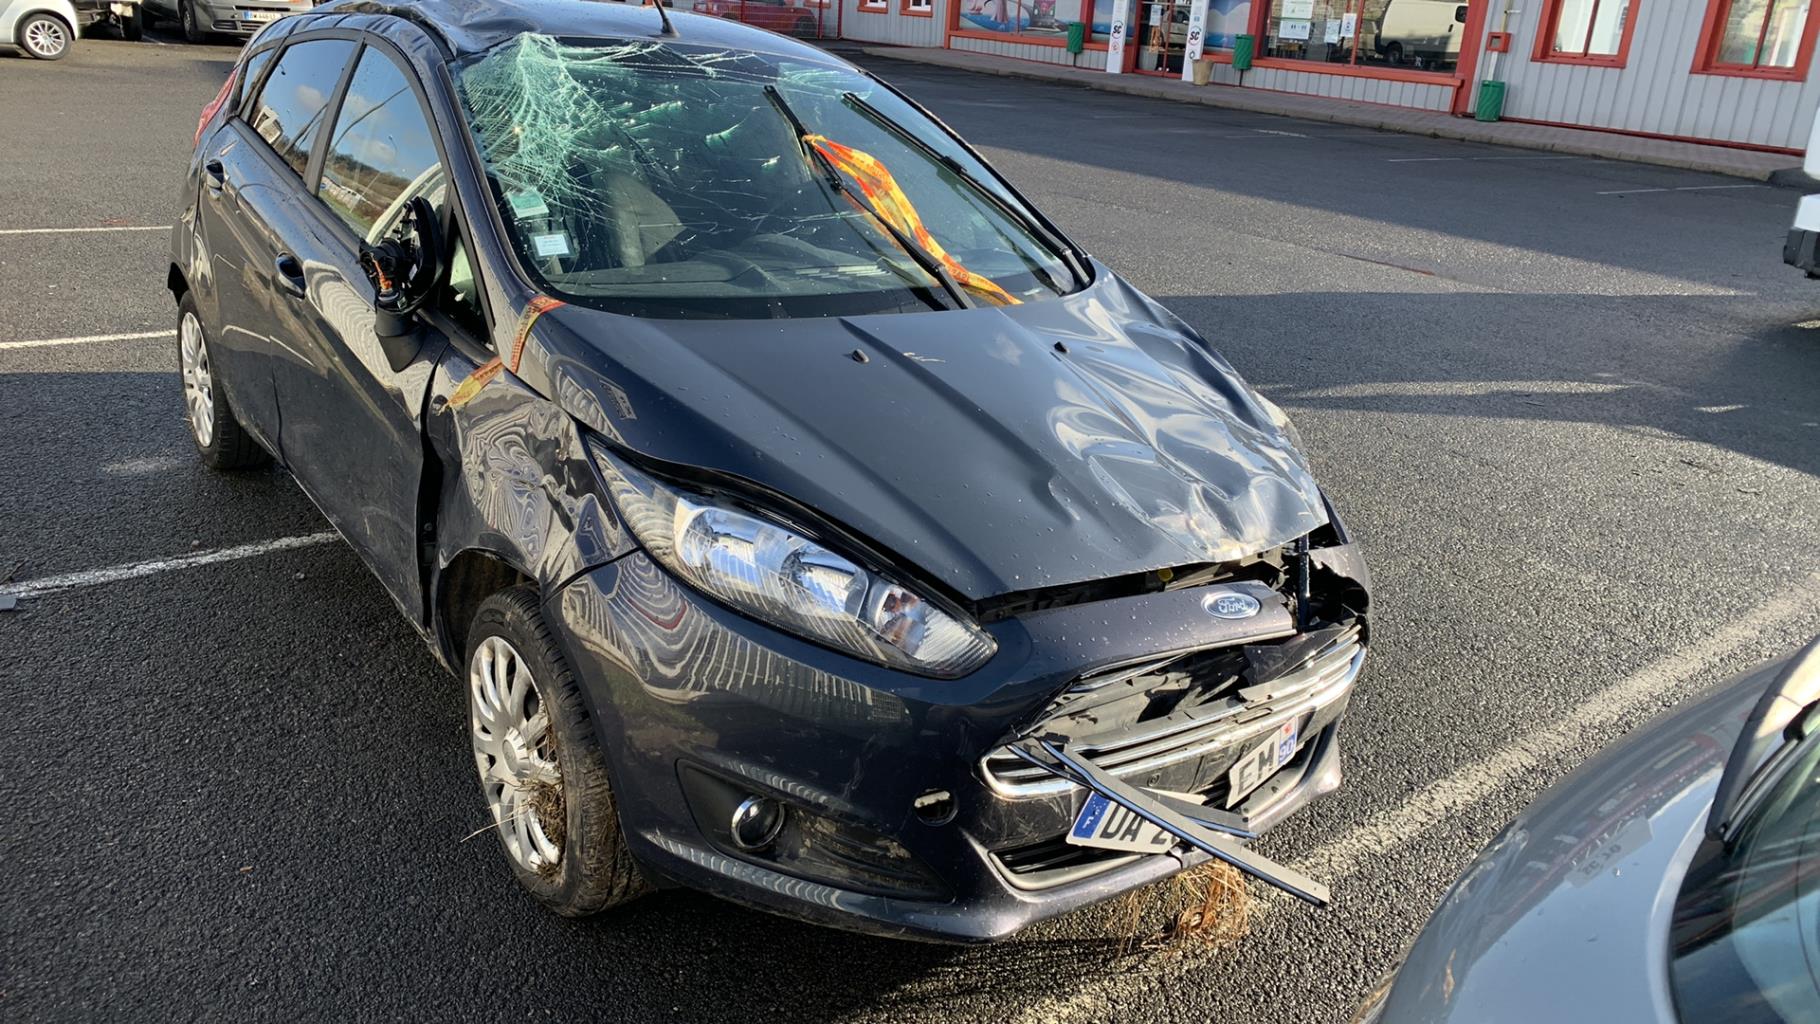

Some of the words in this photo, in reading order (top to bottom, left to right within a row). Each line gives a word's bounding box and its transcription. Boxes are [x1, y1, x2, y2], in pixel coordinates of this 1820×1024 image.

[1113, 25, 1122, 34] SC
[1189, 31, 1200, 41] SC
[1217, 597, 1249, 613] Ford
[1238, 741, 1275, 796] EM
